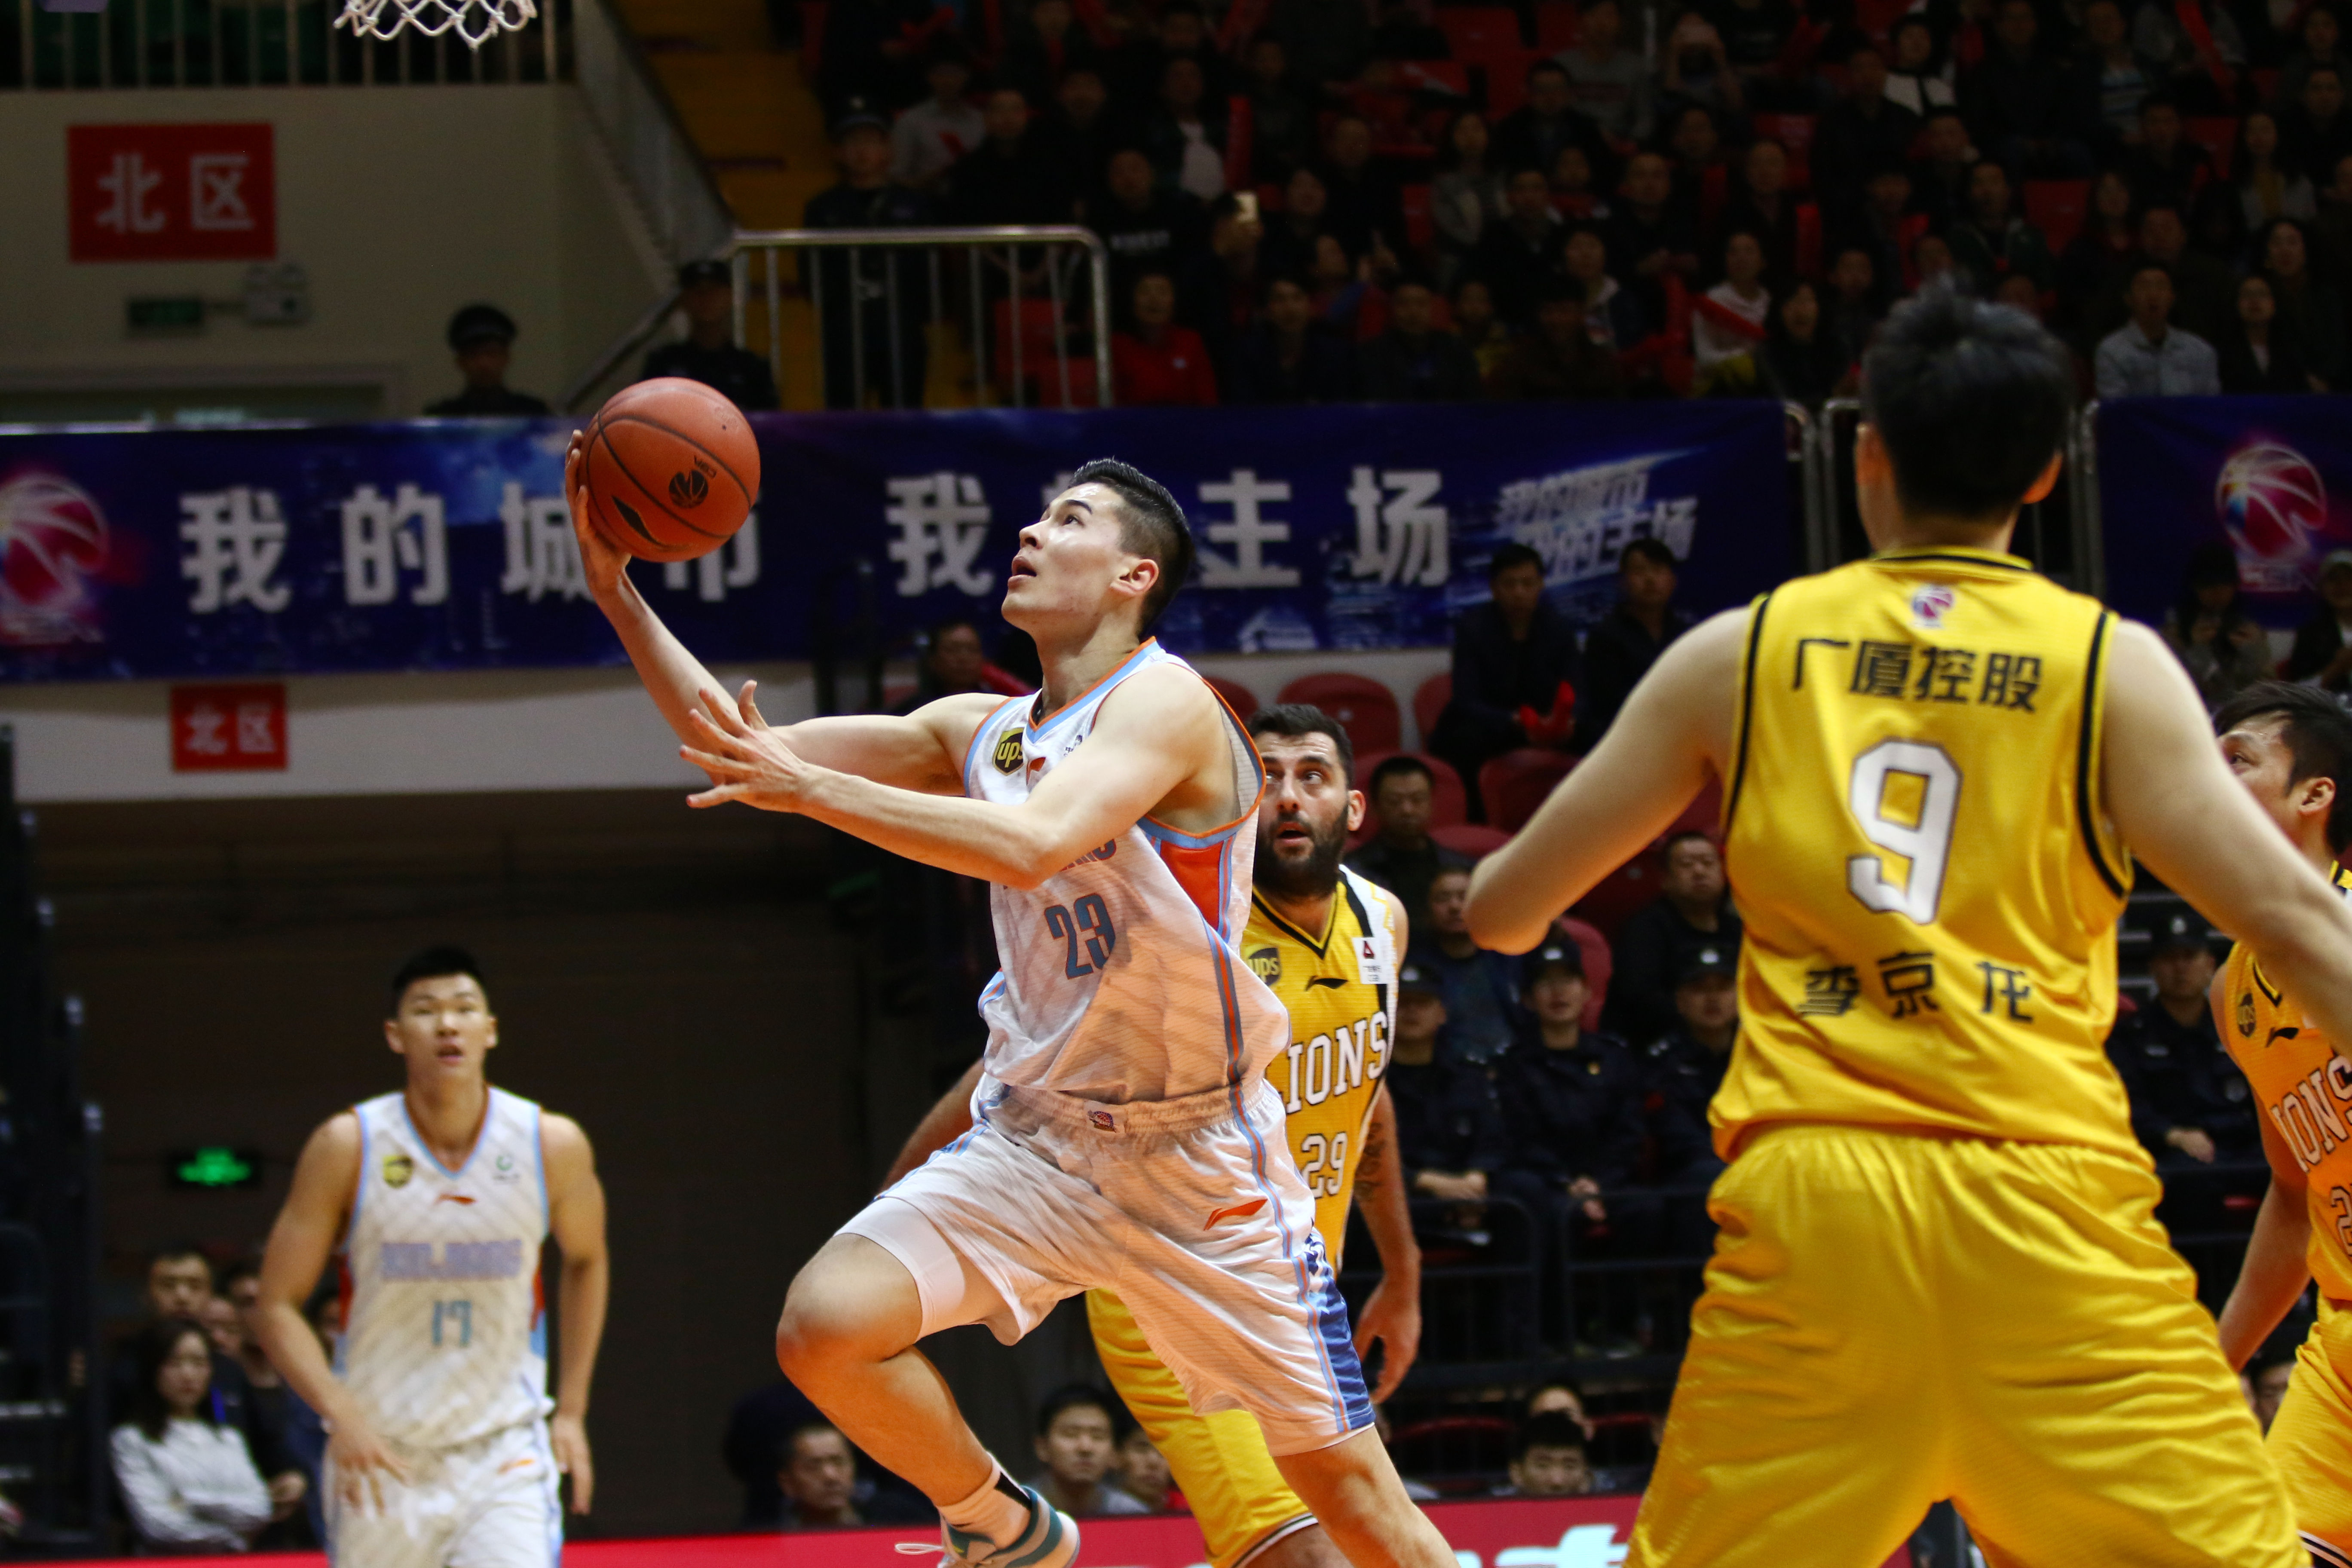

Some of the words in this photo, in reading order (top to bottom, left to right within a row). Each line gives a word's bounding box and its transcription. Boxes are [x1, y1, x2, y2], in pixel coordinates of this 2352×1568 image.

[95, 153, 254, 233] 北区
[885, 467, 1452, 597] 我主场
[1792, 637, 2043, 714] 广厦控股
[1847, 738, 1962, 924] 9
[1044, 893, 1116, 980] 23
[1279, 1010, 1388, 1115] IONS
[1302, 1133, 1348, 1199] 29
[2331, 1183, 2352, 1257] 2
